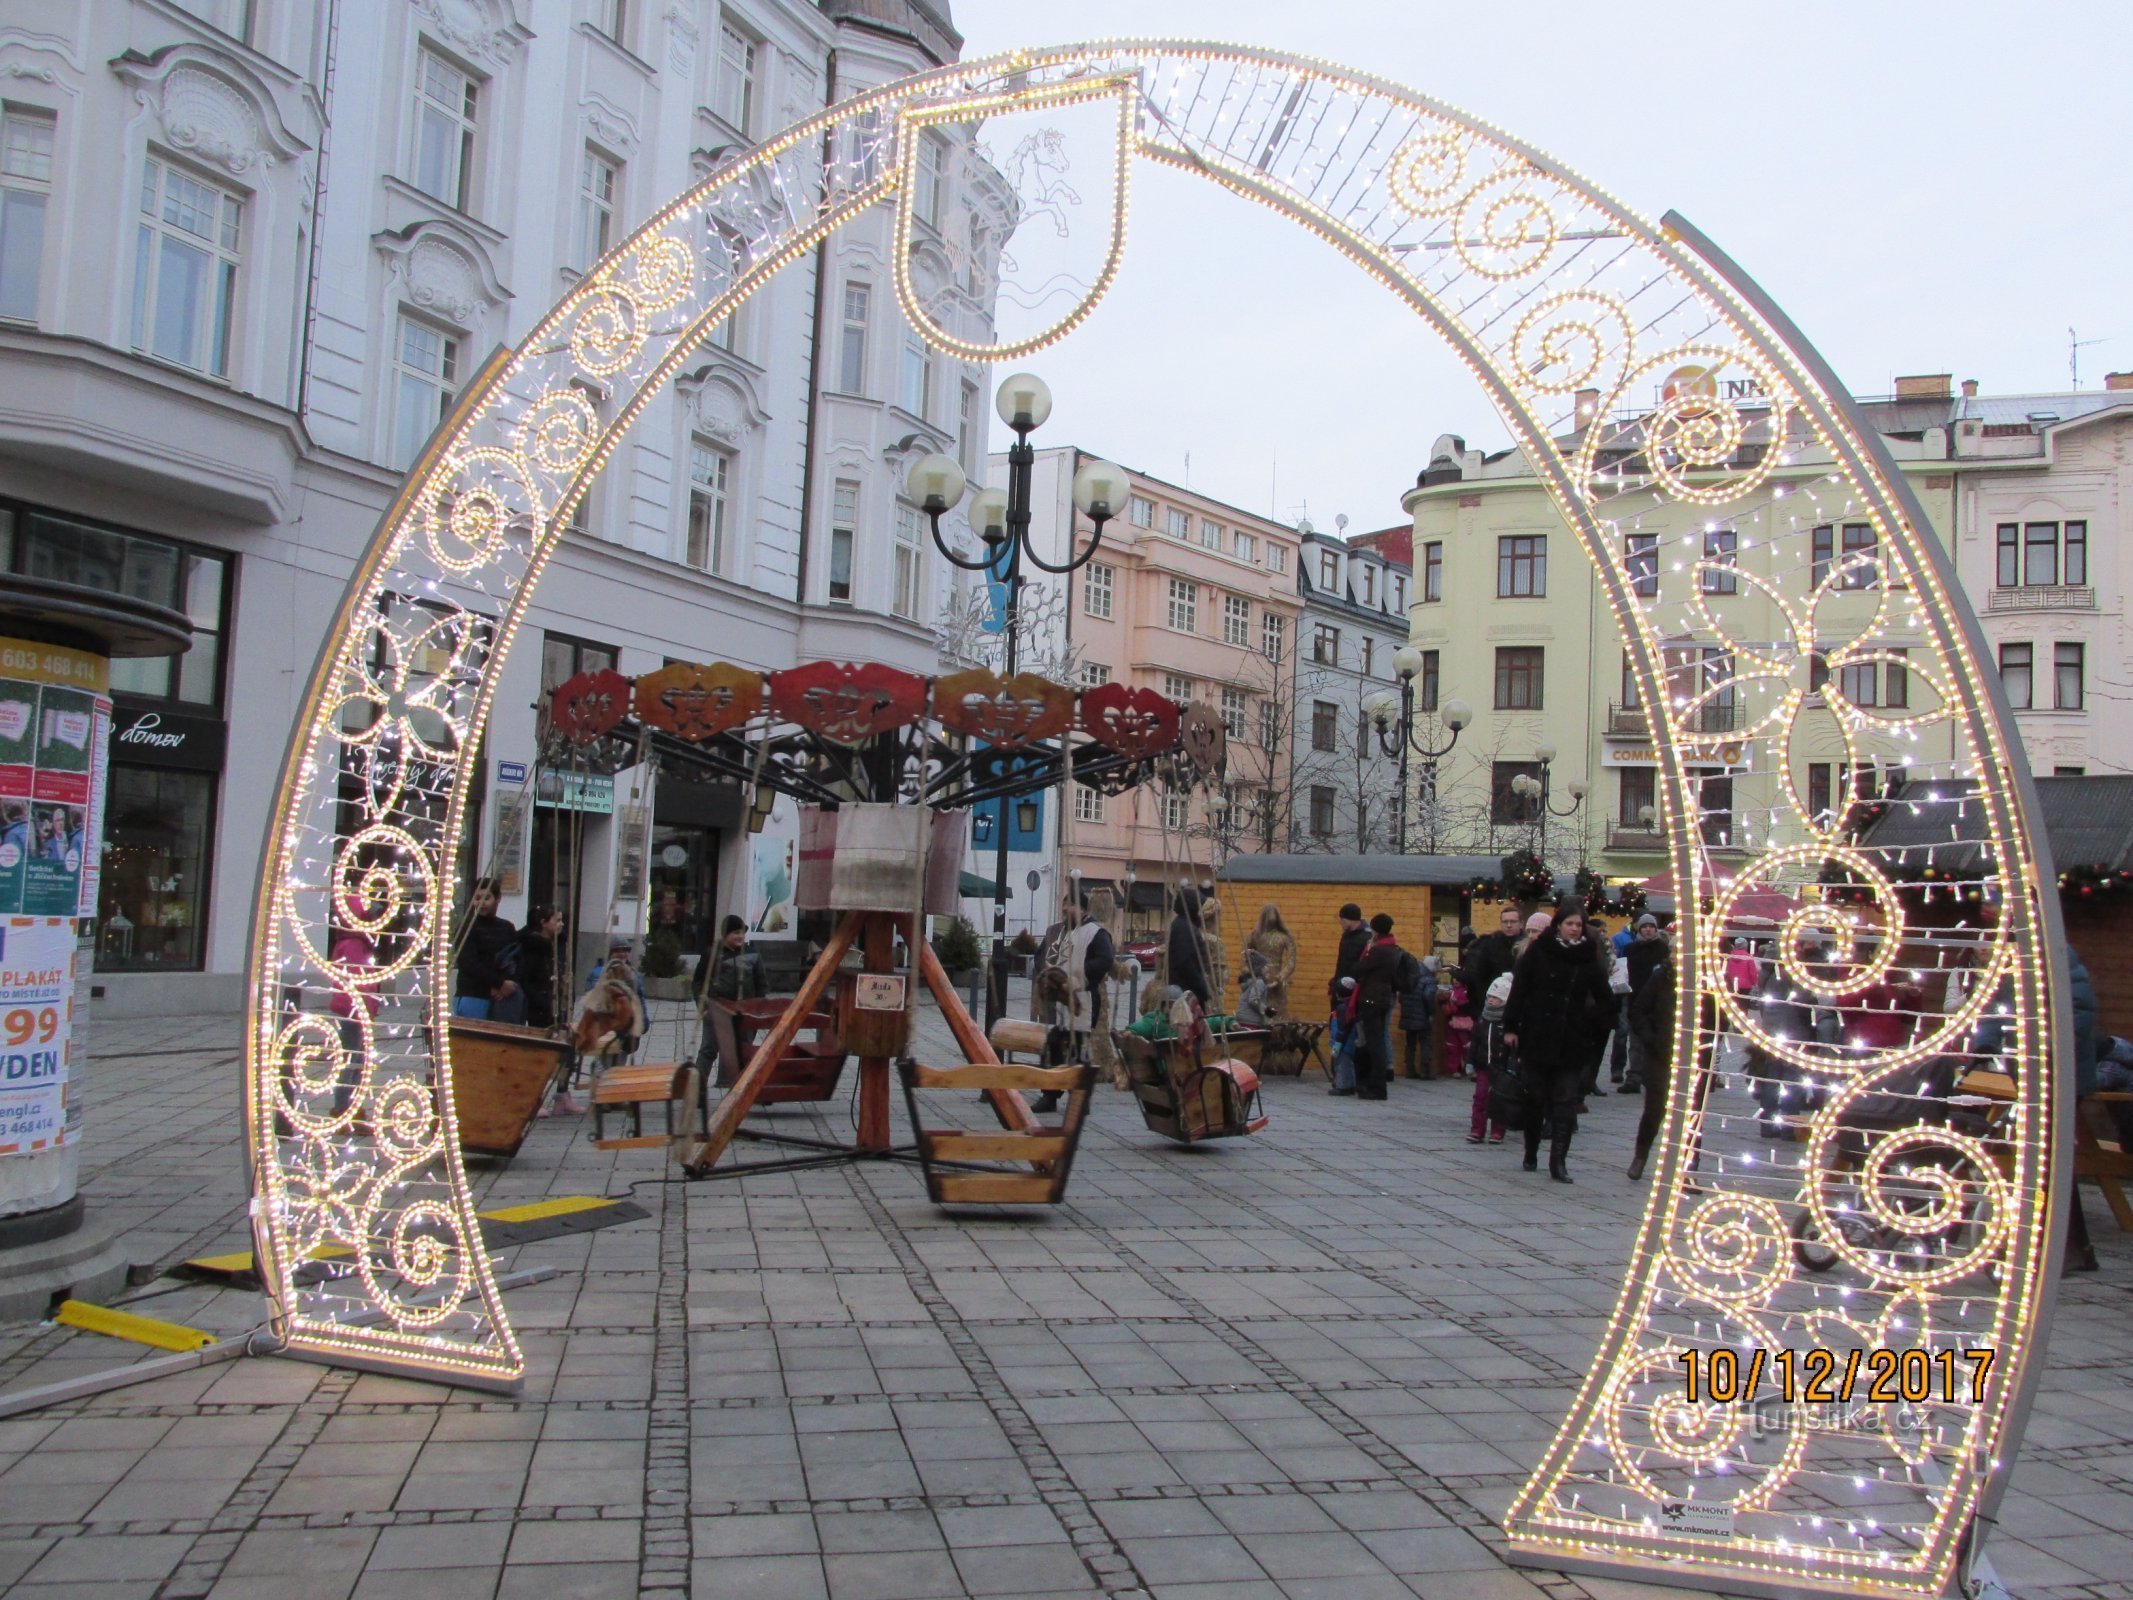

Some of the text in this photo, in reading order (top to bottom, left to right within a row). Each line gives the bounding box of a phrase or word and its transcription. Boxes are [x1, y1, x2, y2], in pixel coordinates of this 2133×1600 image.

[3, 648, 37, 671] 603
[43, 654, 71, 675] 468
[120, 712, 186, 747] domov
[1612, 750, 1719, 762] COMMBANK
[2, 967, 62, 987] PLAKÁT
